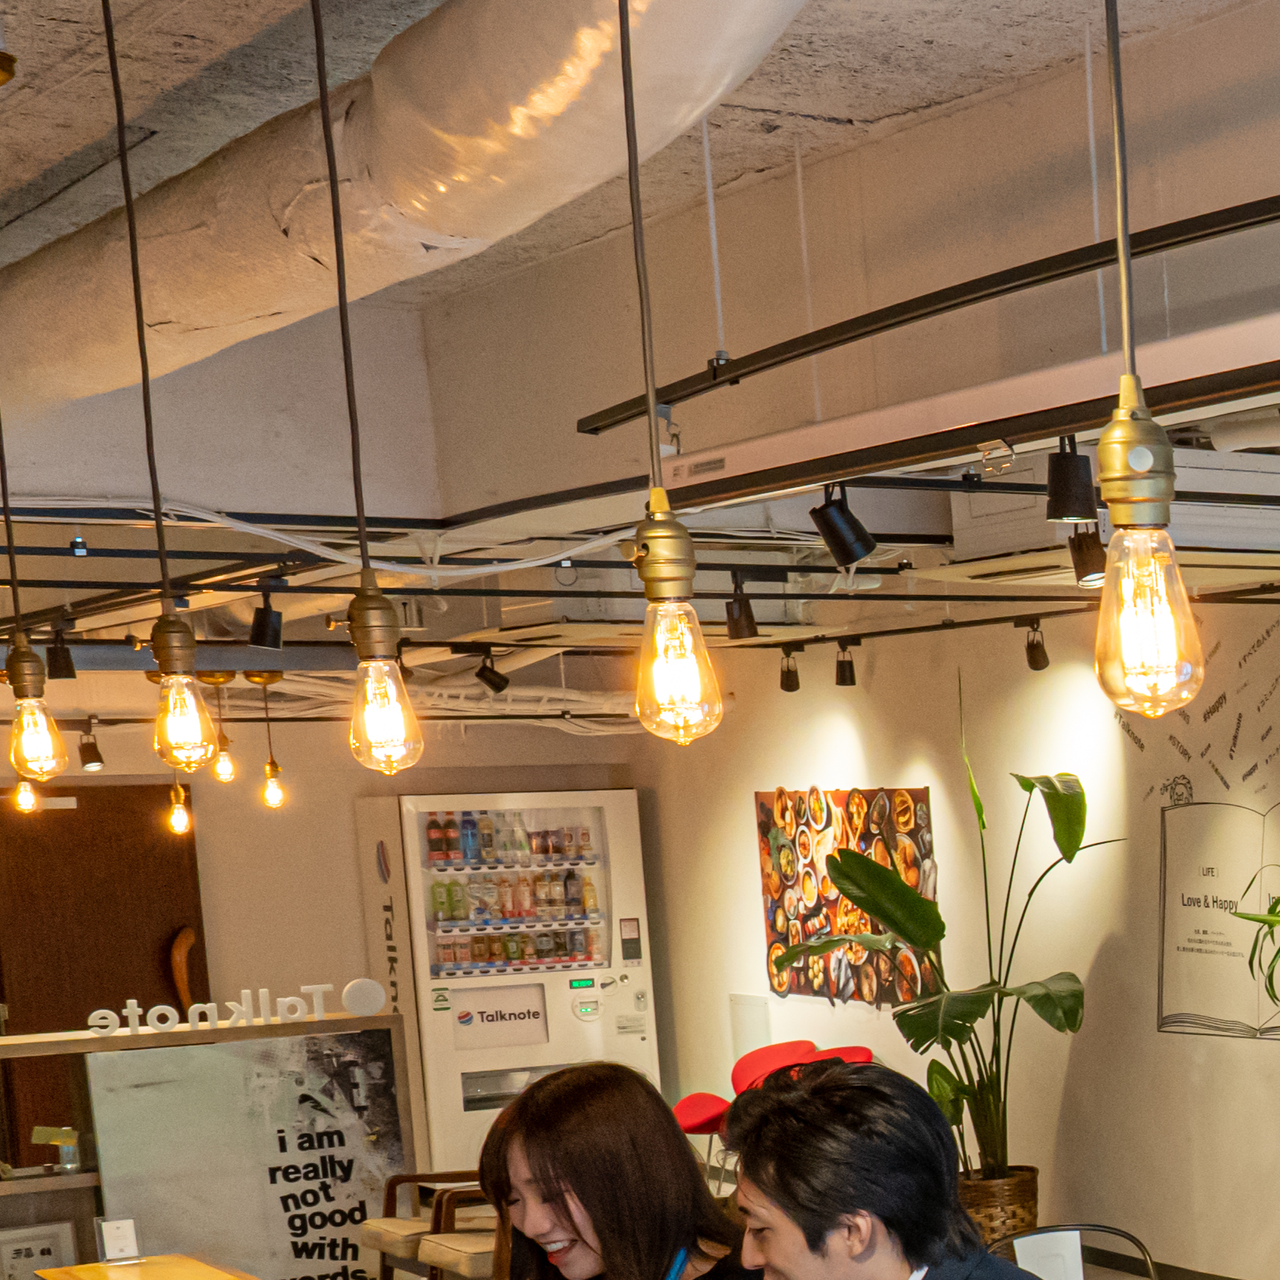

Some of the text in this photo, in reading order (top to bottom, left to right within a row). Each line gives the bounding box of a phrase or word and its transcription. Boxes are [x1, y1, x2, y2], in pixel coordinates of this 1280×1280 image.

[1181, 893, 1239, 913] Love & Happy
[477, 1009, 541, 1024] Talknote
[277, 1129, 346, 1153] i am
[268, 1154, 355, 1185] really
[279, 1180, 336, 1214] not
[287, 1200, 368, 1238] good
[291, 1236, 360, 1262] with
